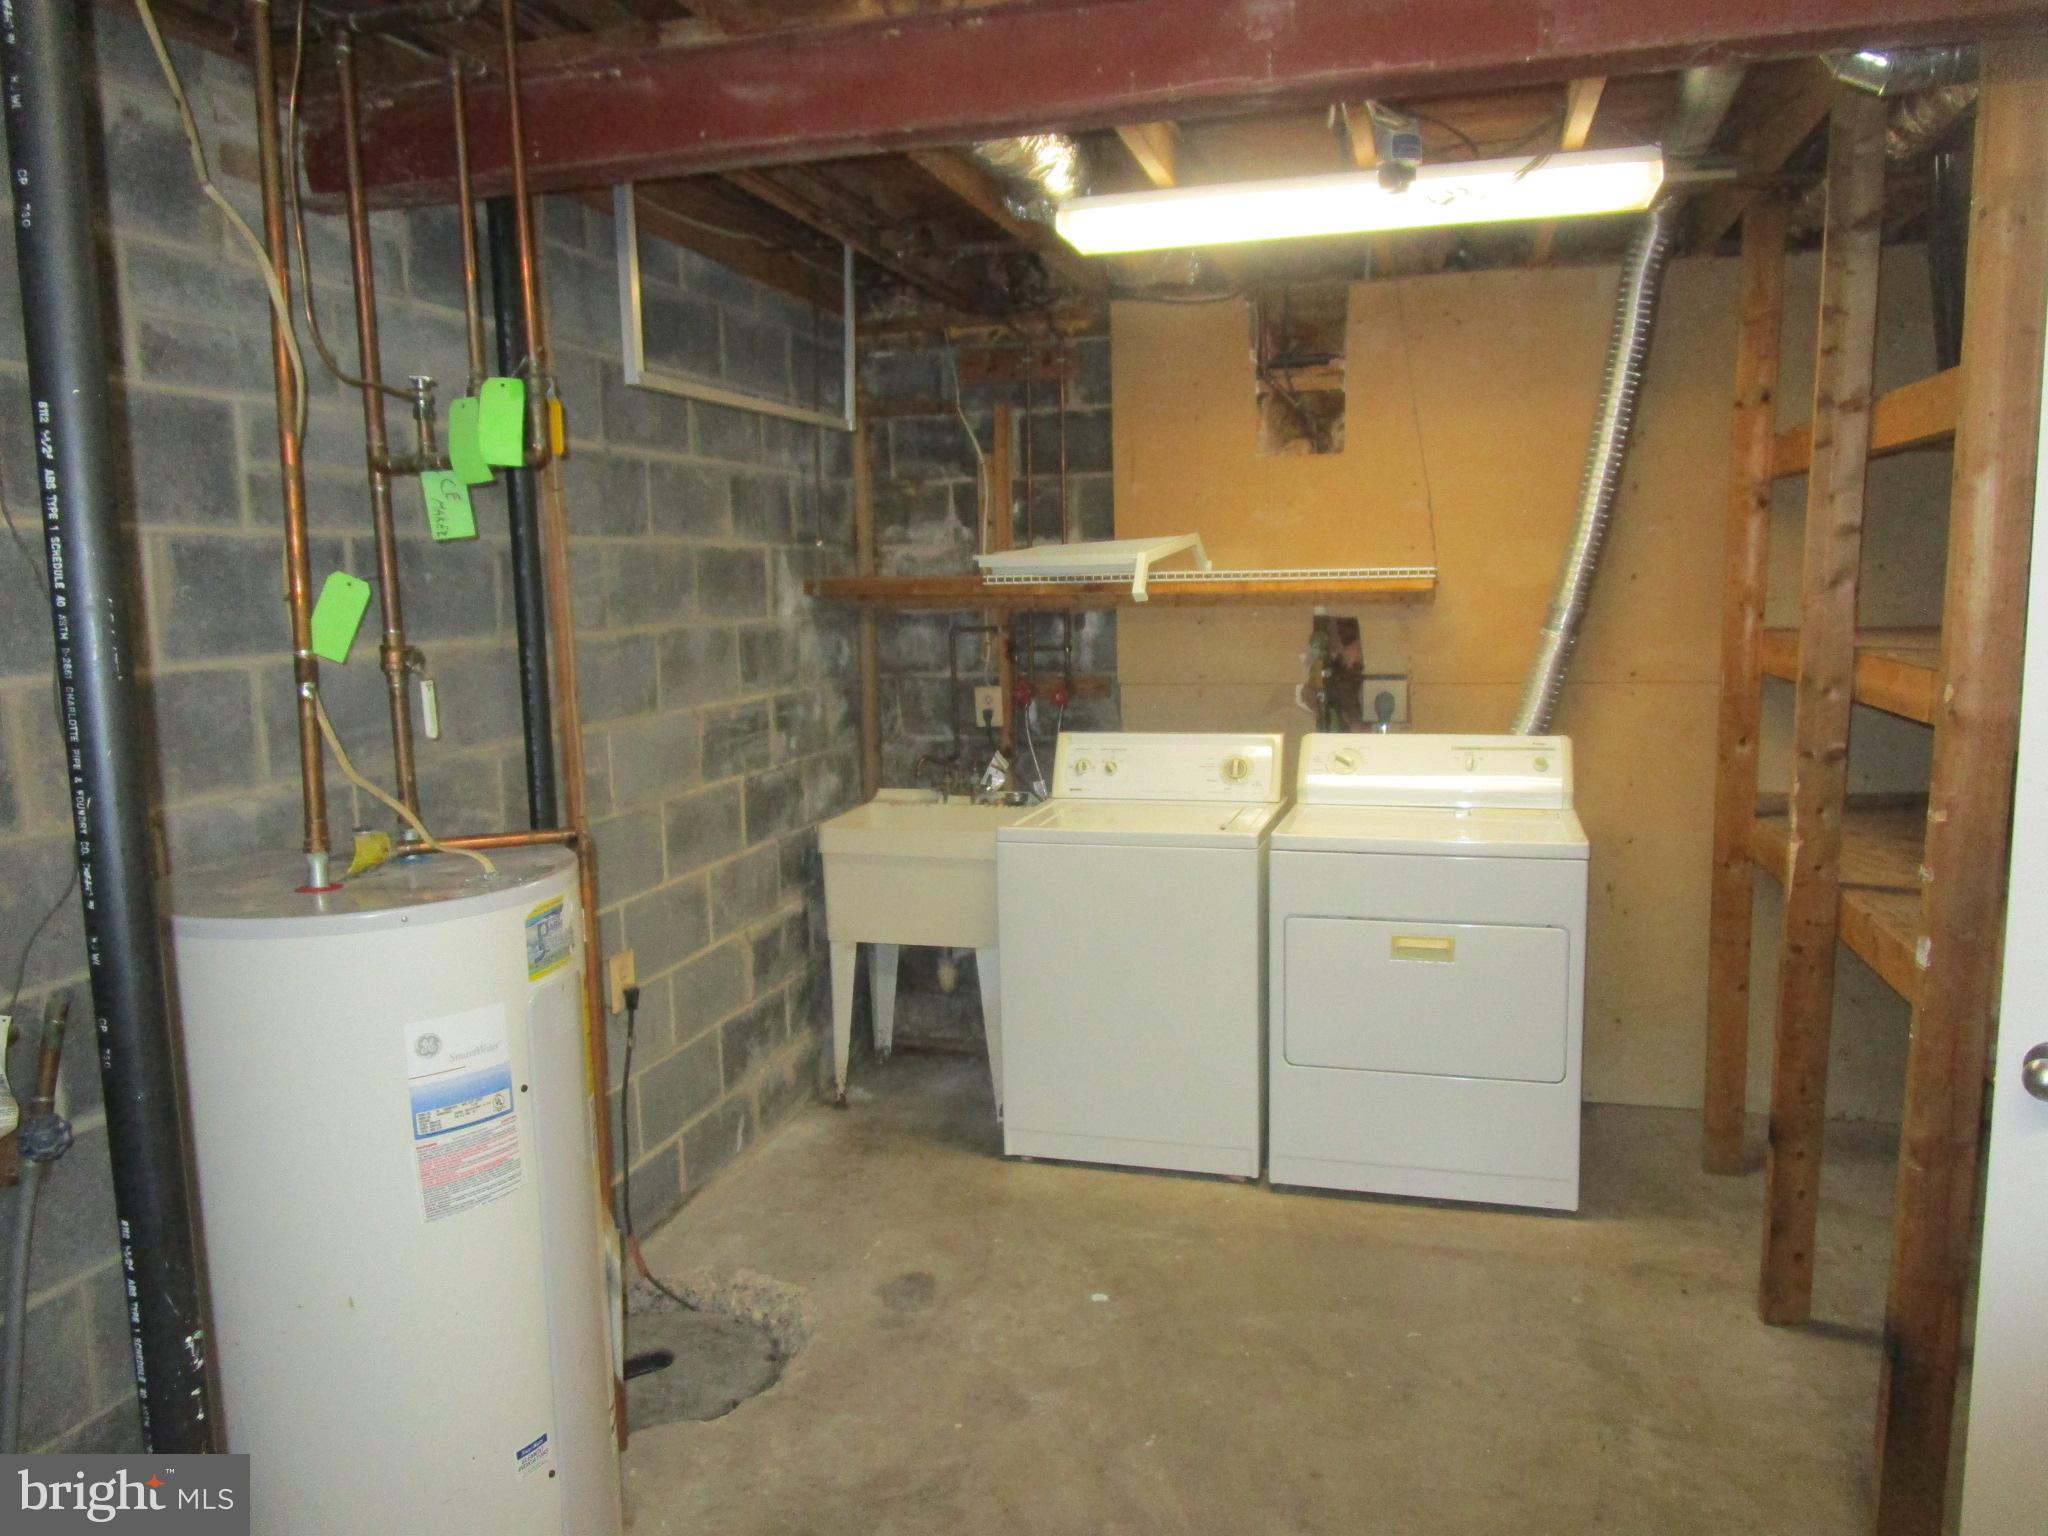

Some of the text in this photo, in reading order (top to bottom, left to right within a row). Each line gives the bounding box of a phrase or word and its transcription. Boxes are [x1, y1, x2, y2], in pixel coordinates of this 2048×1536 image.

[44, 468, 57, 490] ABS
[46, 495, 59, 520] TYPE
[51, 536, 65, 589] SCHEDULE
[56, 595, 66, 608] 40
[58, 614, 69, 640] ASTM
[65, 687, 79, 742] CHARLOTTE
[71, 749, 82, 770] PIPE
[75, 790, 88, 835] FOUNDRY
